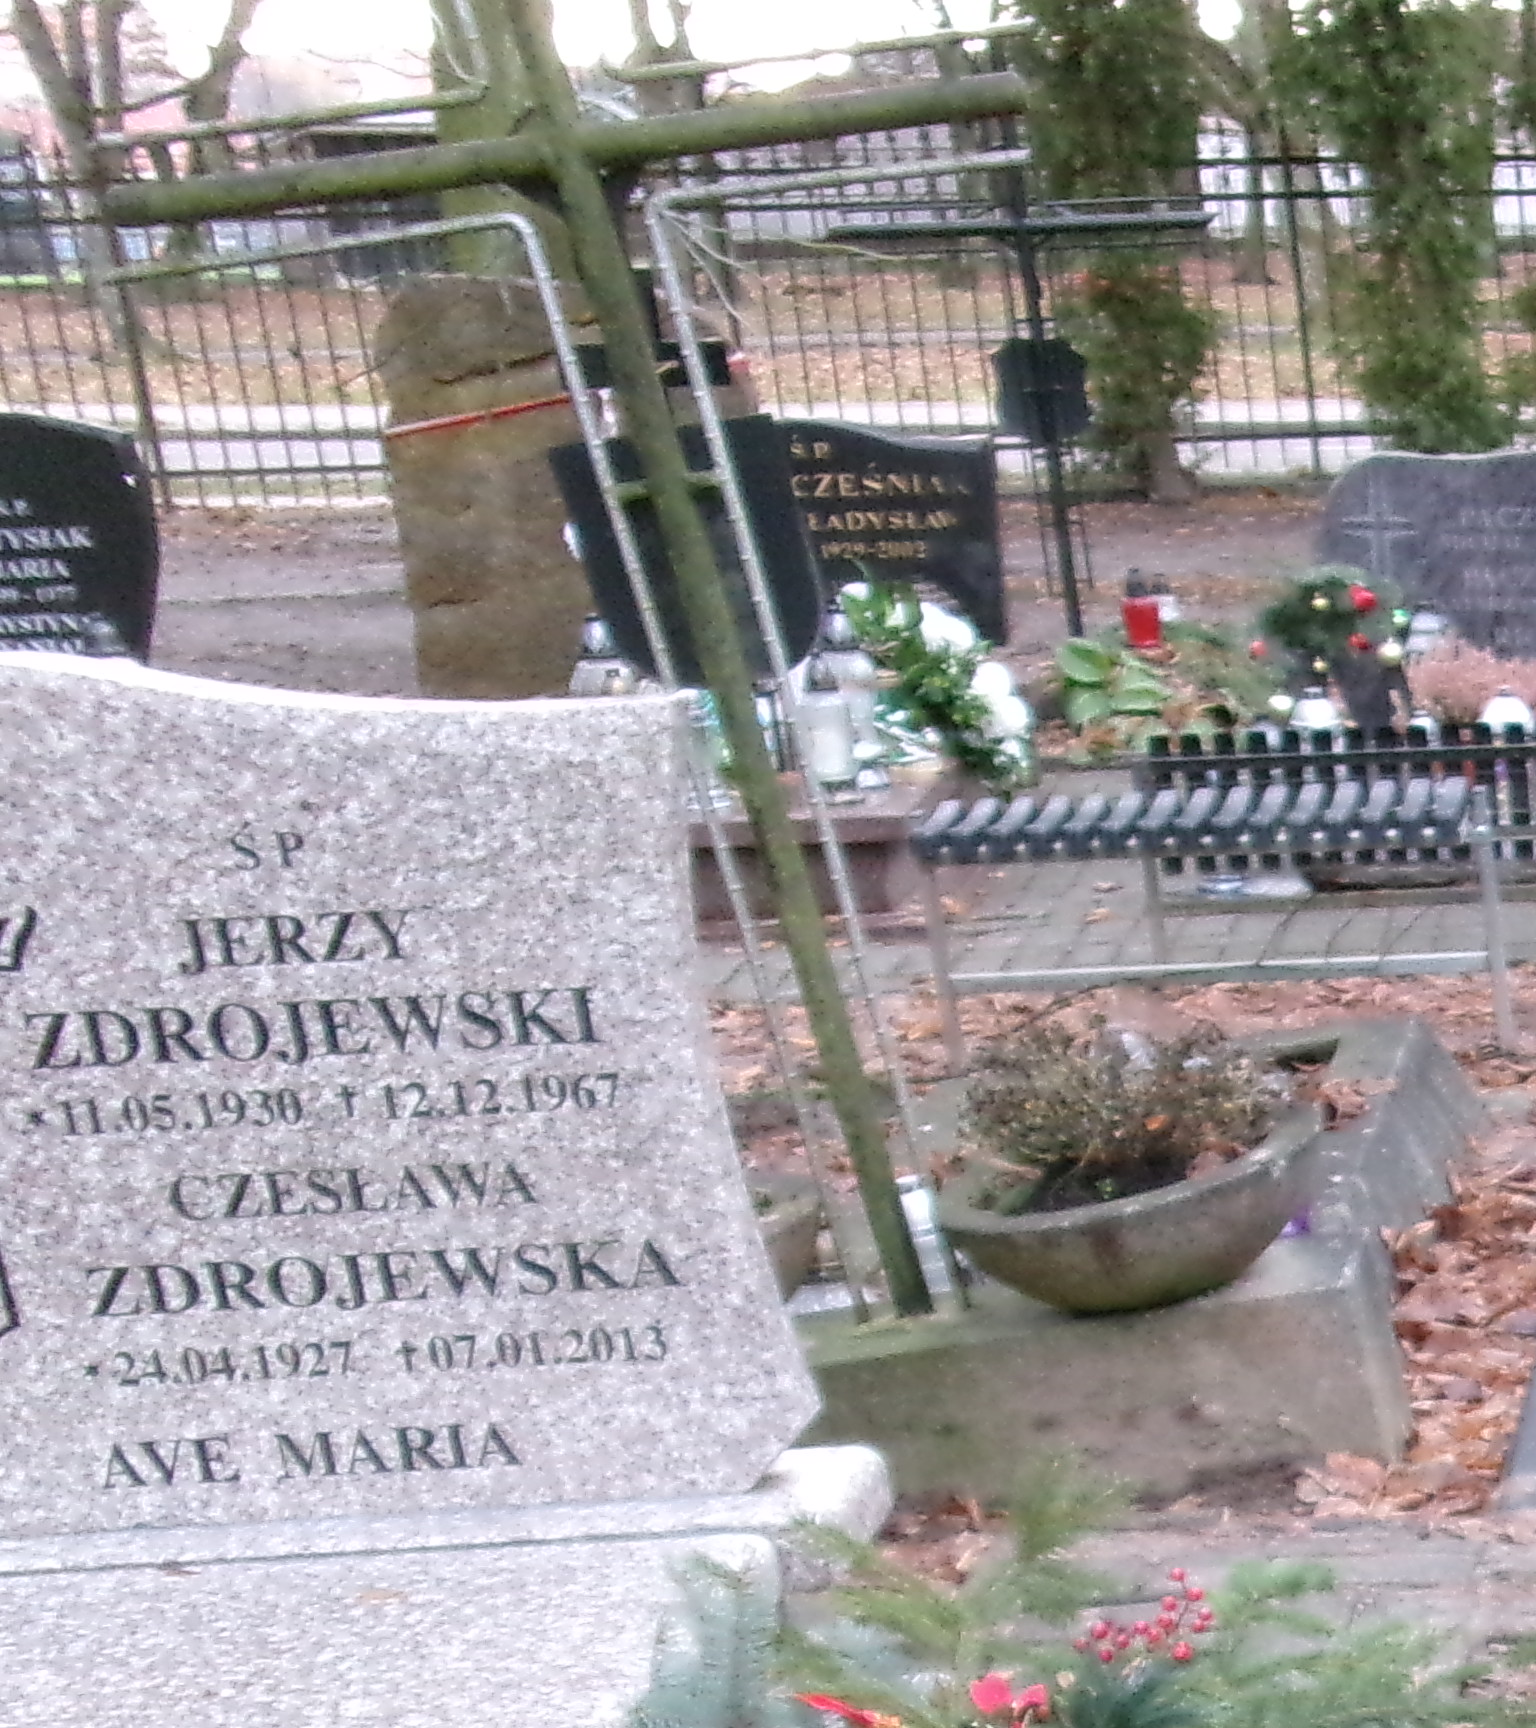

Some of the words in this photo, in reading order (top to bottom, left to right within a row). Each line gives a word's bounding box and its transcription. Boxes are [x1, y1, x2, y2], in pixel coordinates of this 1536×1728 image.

[177, 908, 414, 975] JERZY
[22, 985, 606, 1071] ZDROJEWSKI
[168, 1161, 538, 1223] CZESŁAWA
[86, 1239, 680, 1318] ZDROJEWSKA
[102, 1433, 241, 1490] AVE
[274, 1421, 522, 1480] MARIA
